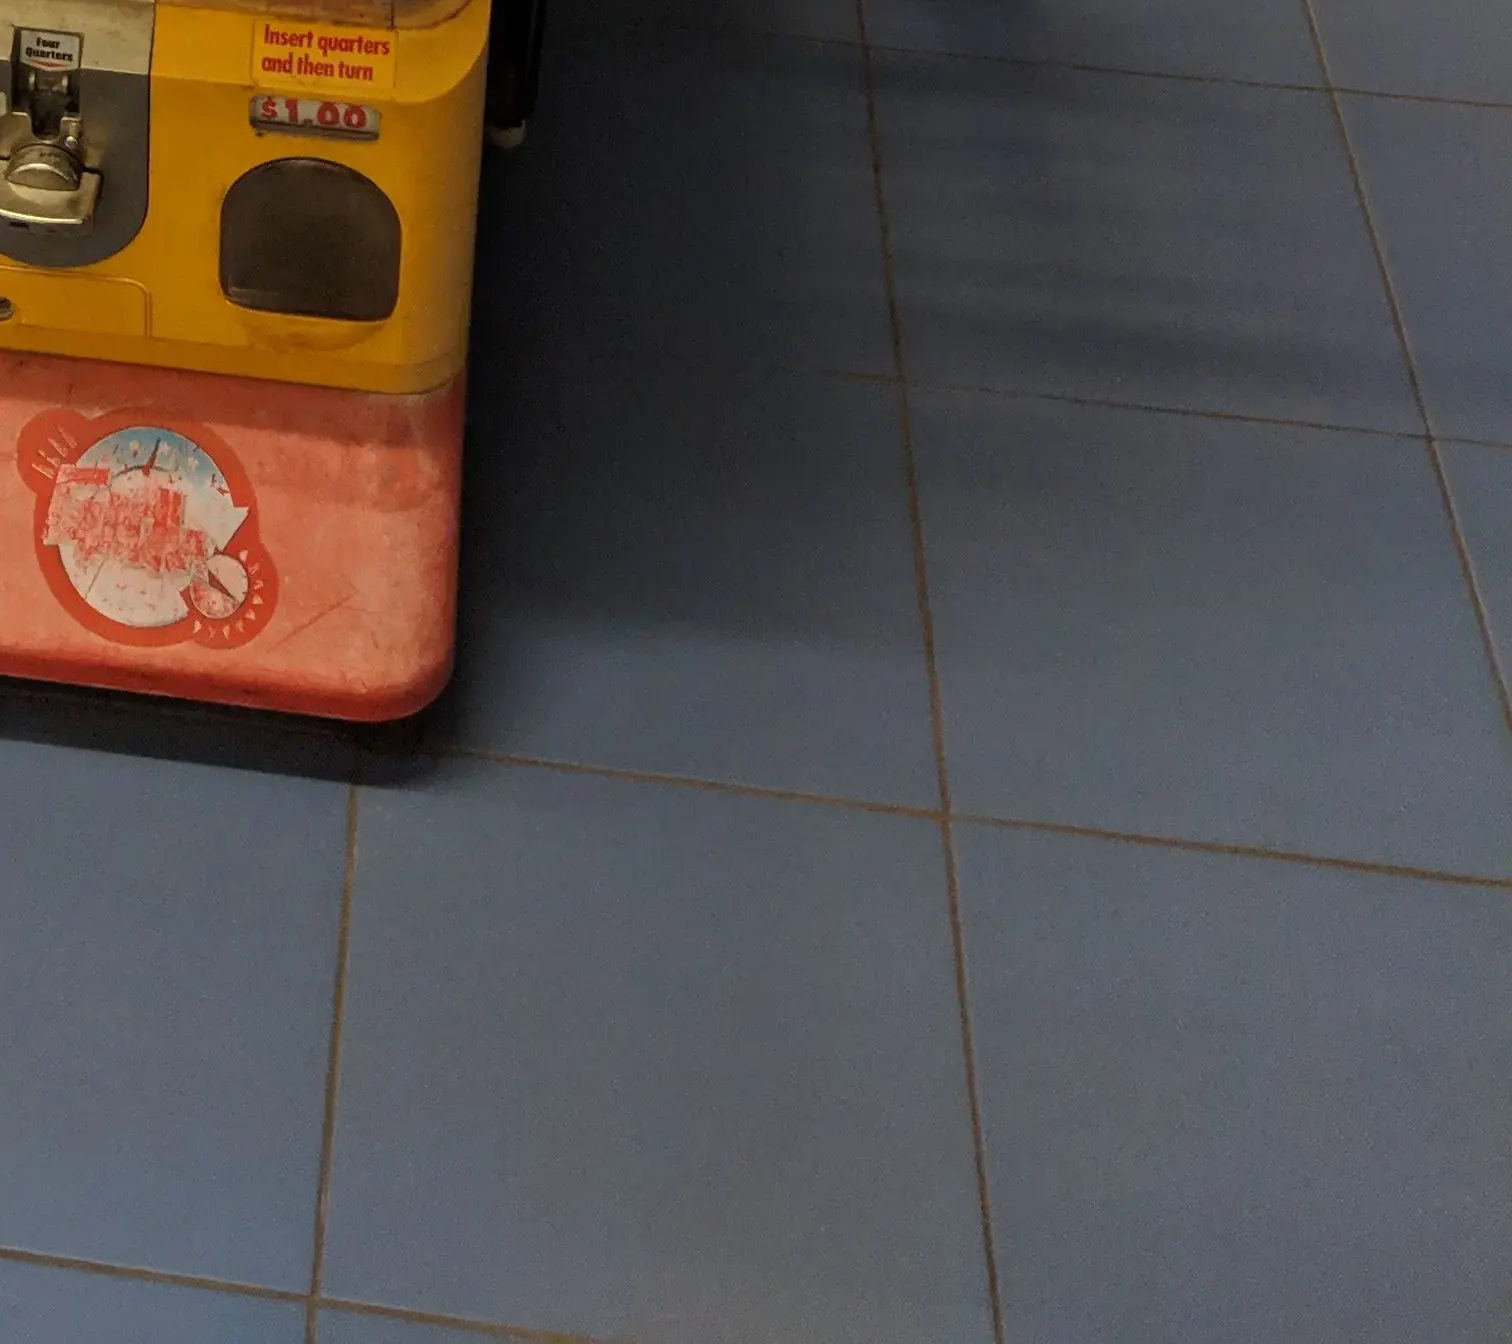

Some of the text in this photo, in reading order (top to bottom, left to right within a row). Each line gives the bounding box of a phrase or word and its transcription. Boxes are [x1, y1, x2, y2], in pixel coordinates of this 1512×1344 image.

[36, 37, 60, 49] Four
[264, 23, 391, 56] Insert quarters
[25, 47, 73, 62] Quarters
[262, 52, 374, 81] and then turn
[261, 95, 367, 128] $1.00
